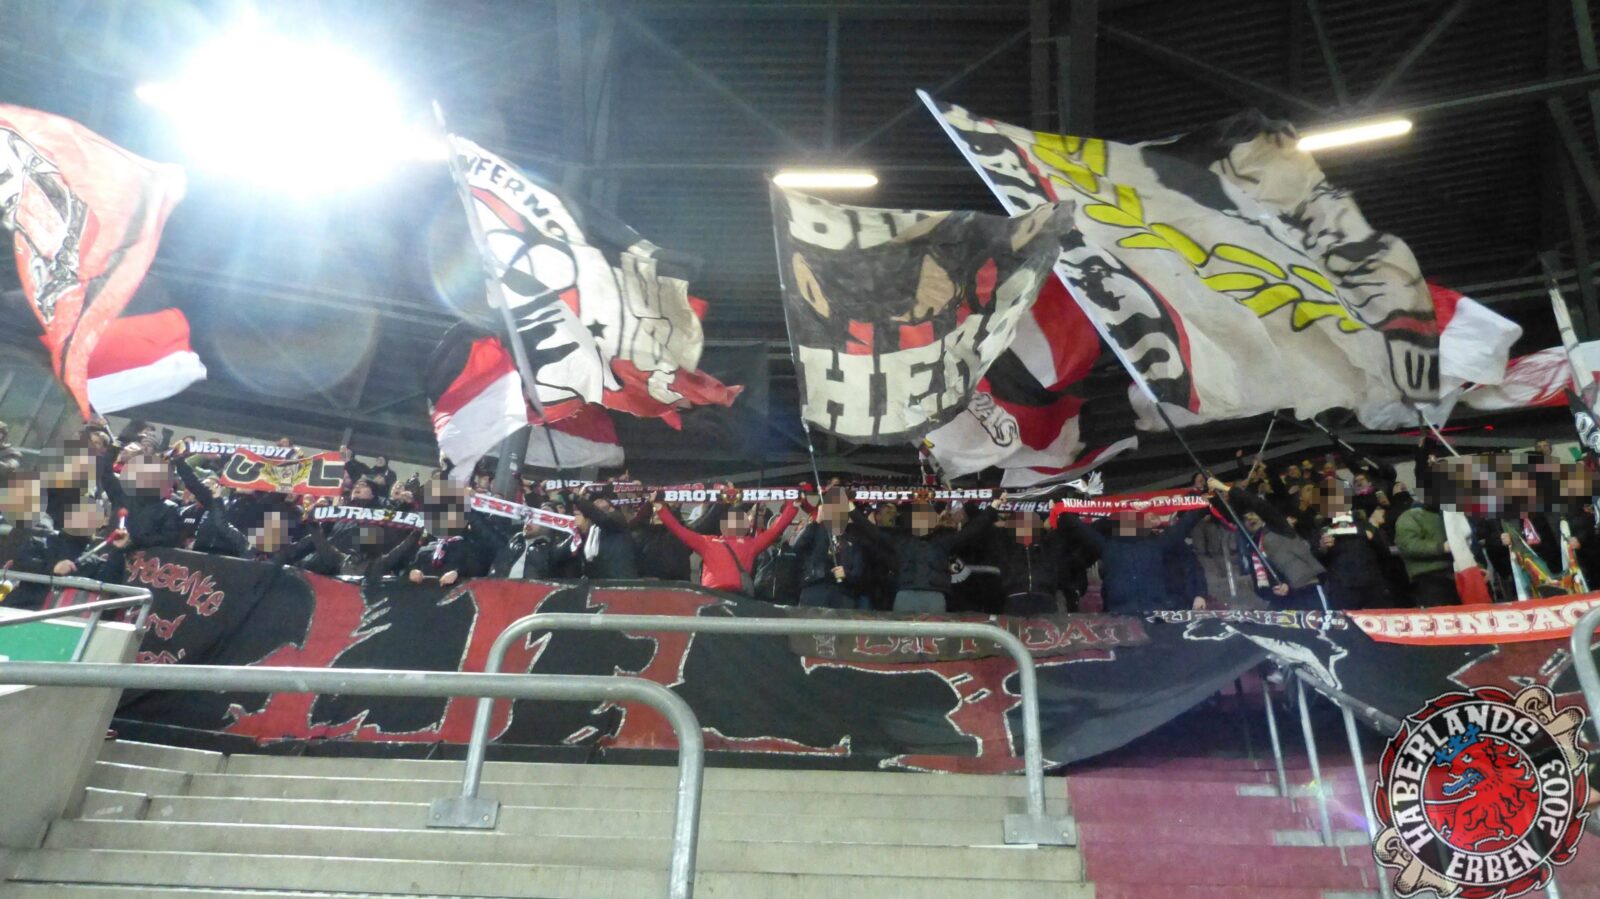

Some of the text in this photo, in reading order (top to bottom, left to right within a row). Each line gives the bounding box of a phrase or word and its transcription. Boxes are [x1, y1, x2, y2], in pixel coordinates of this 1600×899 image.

[664, 489, 799, 502] BROT HERS
[855, 489, 993, 500] BROT HERS
[314, 506, 385, 521] ULTRAS
[1356, 602, 1600, 636] OFFENBAC
